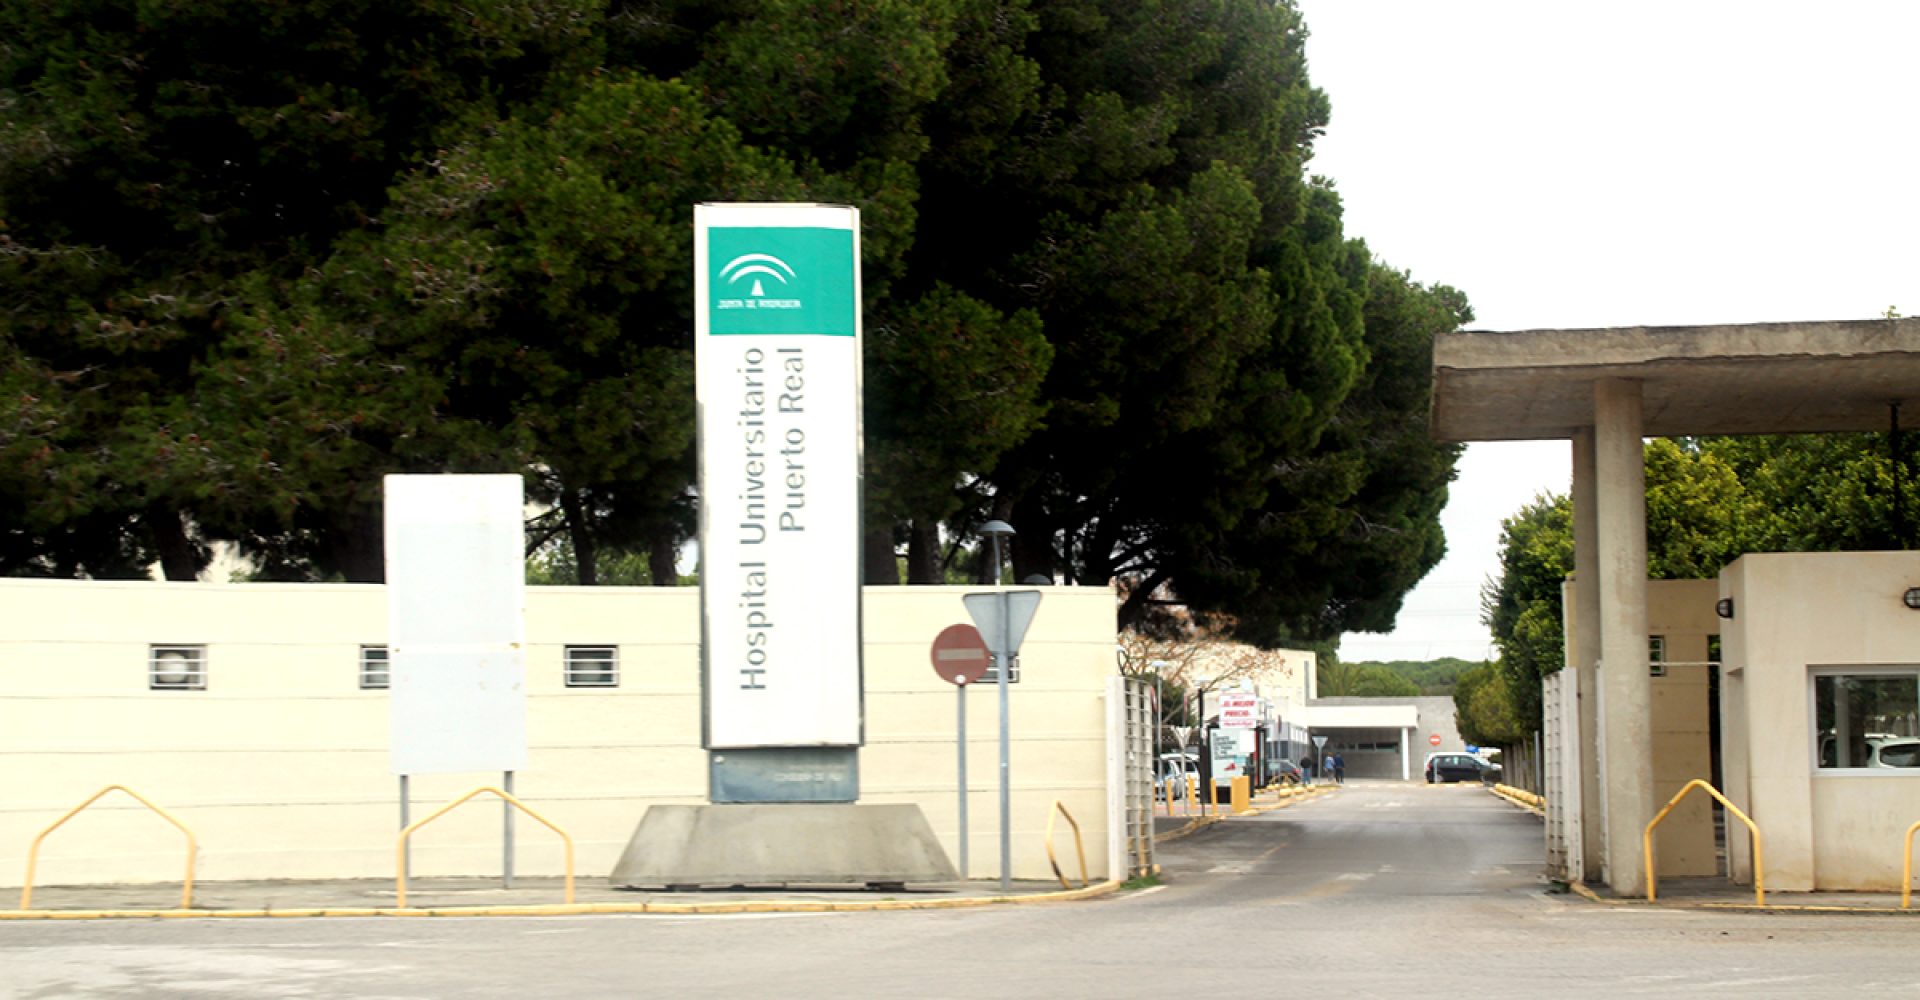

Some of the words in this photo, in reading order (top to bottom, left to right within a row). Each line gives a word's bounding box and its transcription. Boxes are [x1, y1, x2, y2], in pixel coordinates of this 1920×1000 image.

[777, 348, 804, 413] Real
[738, 348, 766, 545] Universitario
[778, 428, 805, 532] Puerto
[739, 562, 773, 690] Hospital
